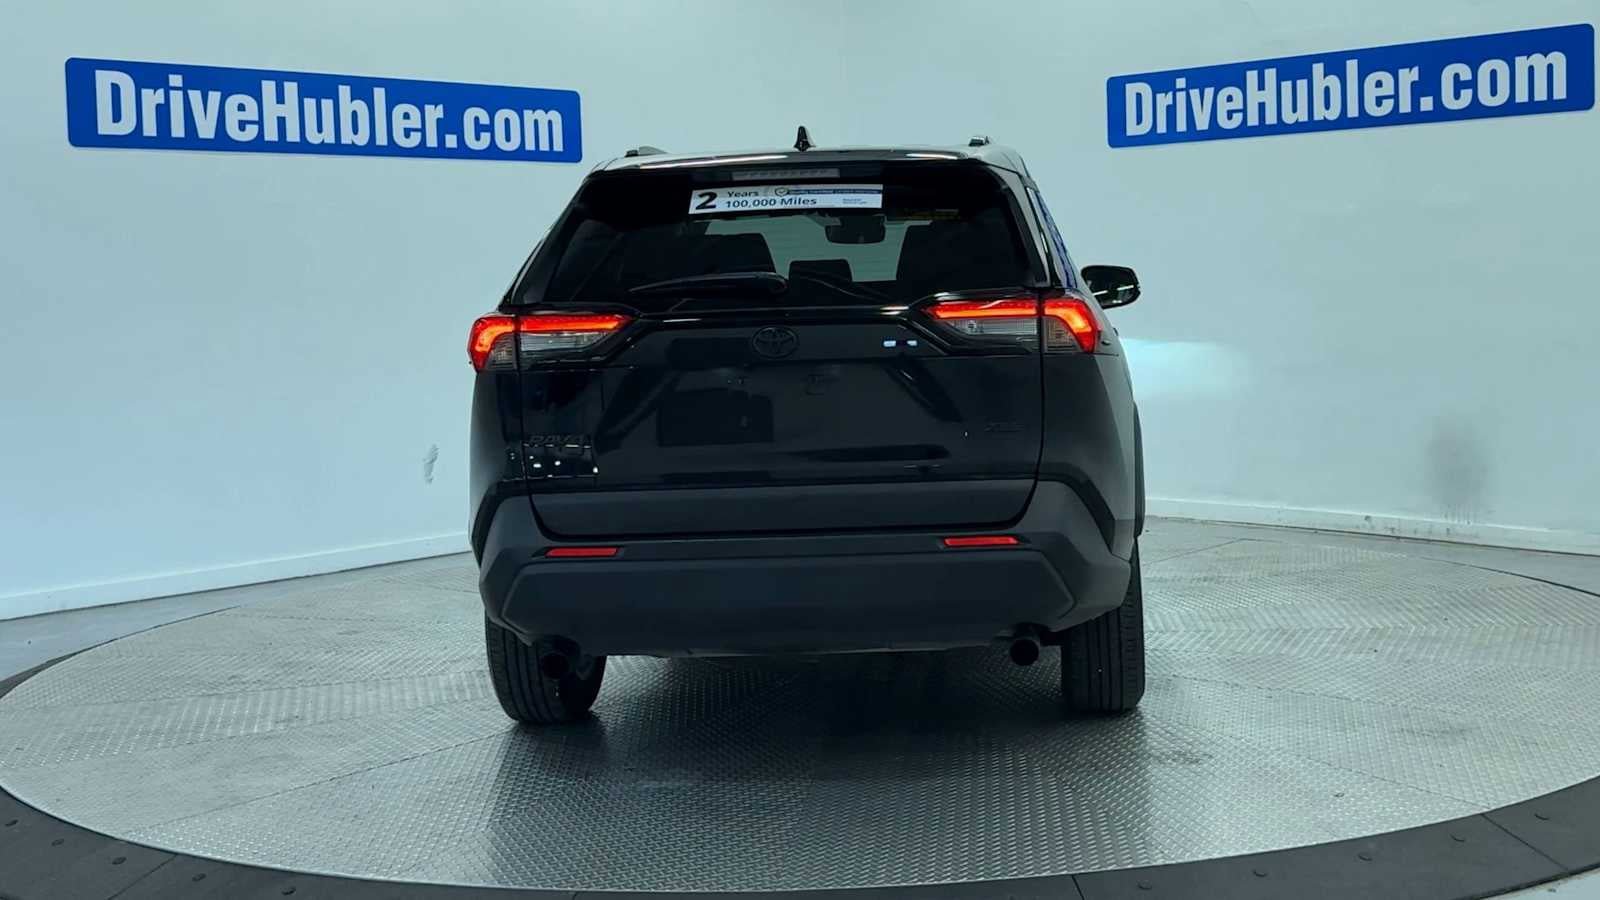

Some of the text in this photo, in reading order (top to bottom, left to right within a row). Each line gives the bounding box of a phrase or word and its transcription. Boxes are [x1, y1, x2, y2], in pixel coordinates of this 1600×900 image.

[95, 69, 564, 152] DriveHubler.com
[1125, 50, 1567, 137] DriveHubler.com
[695, 190, 759, 210] 2 Years
[726, 198, 817, 208] 100,000 Miles
